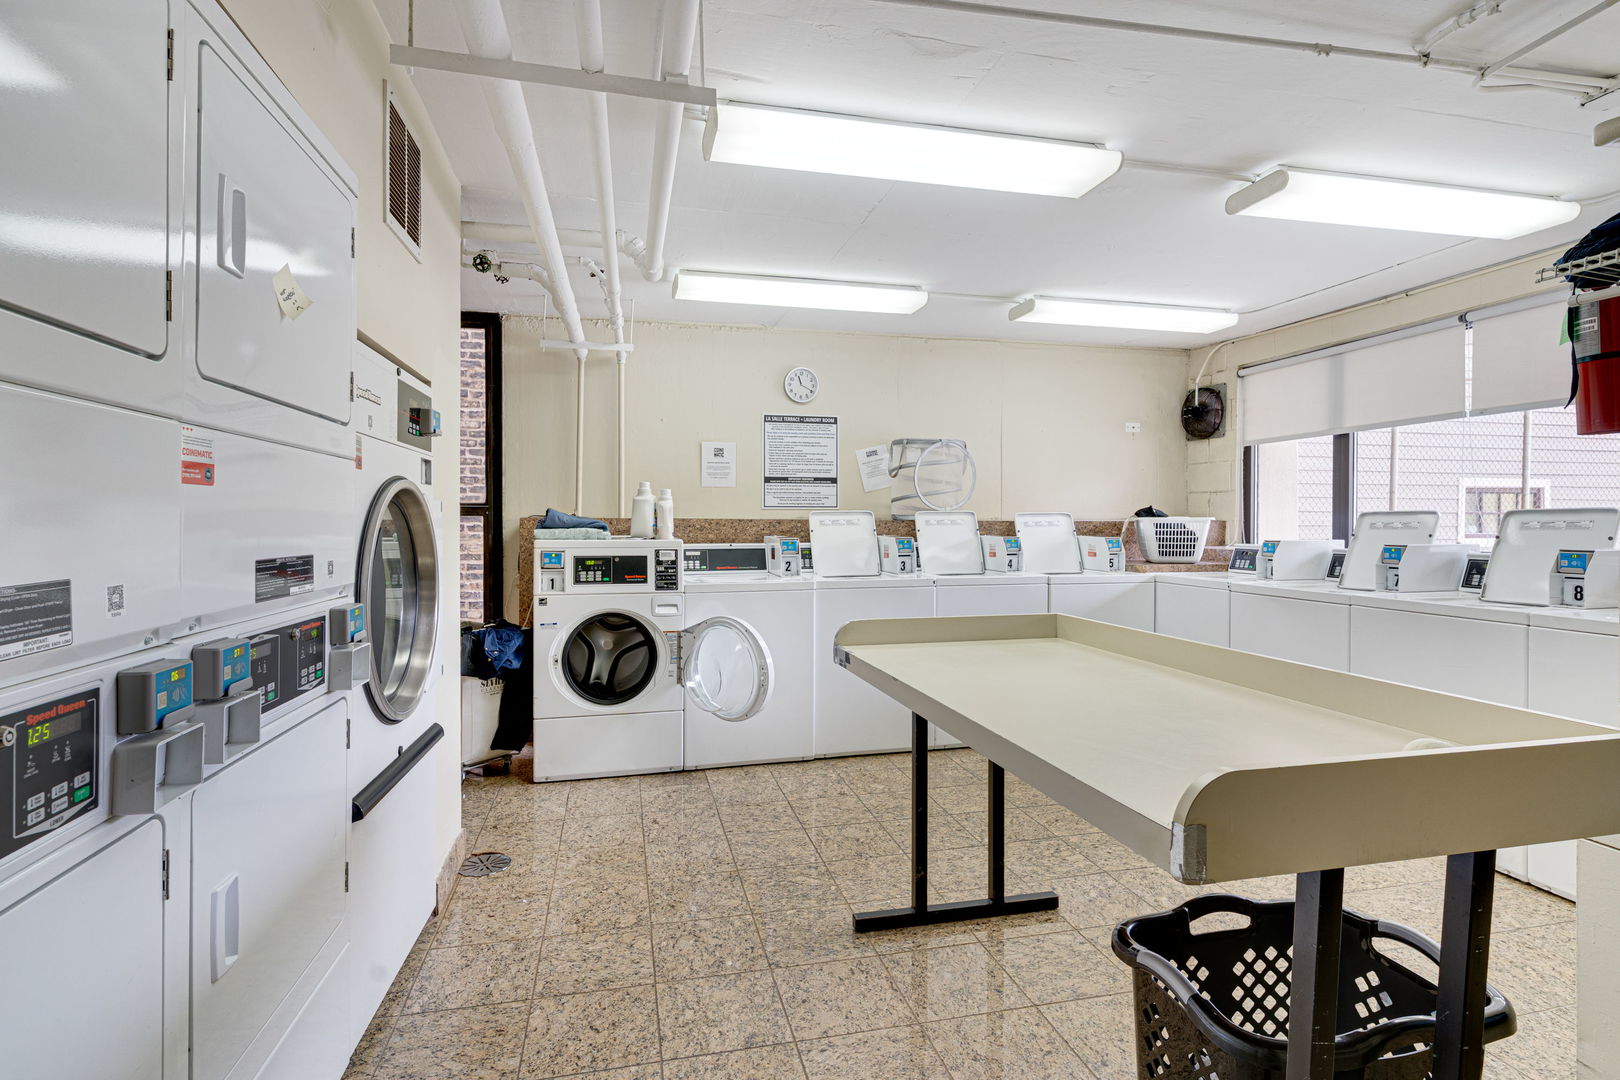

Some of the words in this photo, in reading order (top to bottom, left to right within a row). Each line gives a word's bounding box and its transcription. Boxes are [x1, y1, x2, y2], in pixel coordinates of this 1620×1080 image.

[785, 561, 791, 572] 2
[900, 560, 906, 571] 3
[1007, 559, 1013, 569] 4
[1109, 558, 1114, 568] 5
[550, 578, 555, 590] 1
[1574, 585, 1584, 601] 8
[26, 706, 57, 725] Speed
[57, 700, 86, 714] Queen
